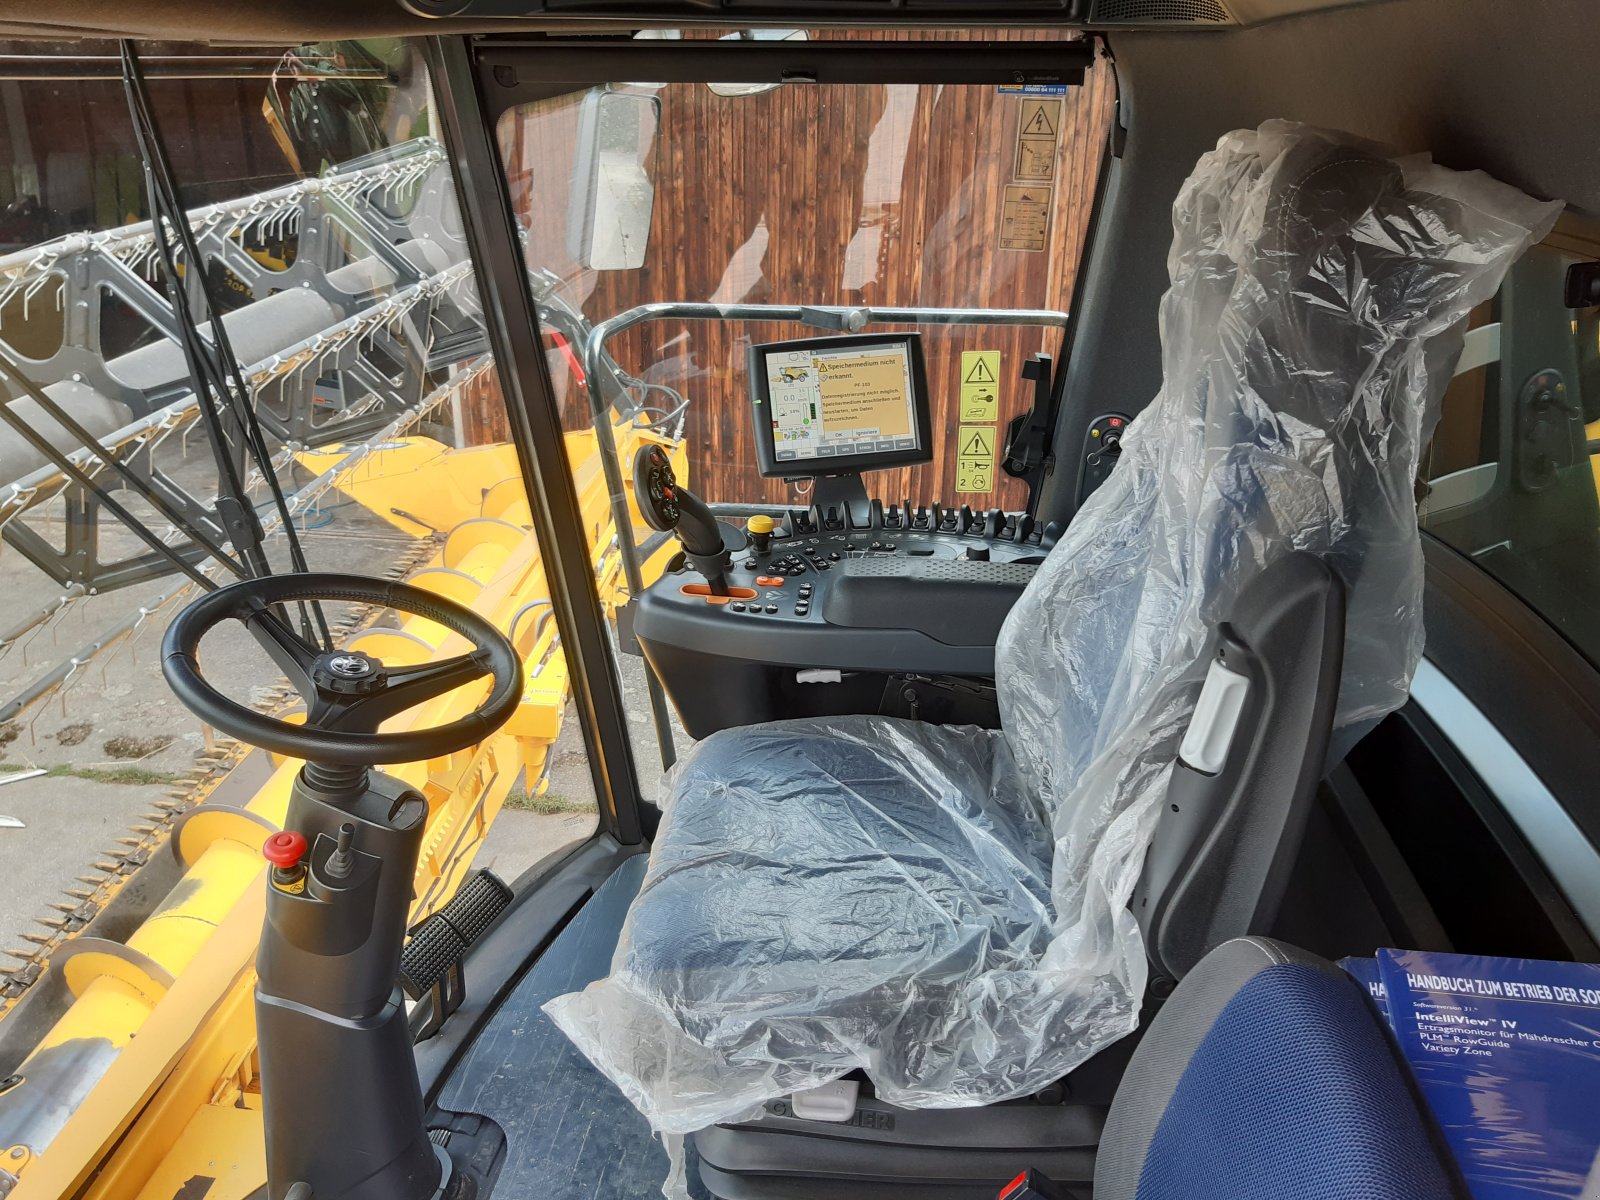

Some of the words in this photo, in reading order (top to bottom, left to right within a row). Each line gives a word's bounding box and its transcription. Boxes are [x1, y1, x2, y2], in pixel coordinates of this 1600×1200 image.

[828, 361, 879, 370] Speichermedium
[828, 372, 854, 380] erkannt.
[960, 479, 966, 487] 2
[1406, 973, 1475, 994] HANDBUCH
[1476, 979, 1503, 996] ZUM
[1503, 982, 1553, 1001] BETRIEB
[1553, 986, 1580, 1003] DER
[1413, 1001, 1462, 1011] Softwareversion
[1501, 1020, 1517, 1029] IV
[1418, 1022, 1496, 1037] Ertragsmonitor
[1500, 1030, 1515, 1039] für
[1518, 1032, 1590, 1047] Mähdrescher
[1453, 1036, 1511, 1049] RowGuide
[1421, 1042, 1460, 1055] Variety
[1463, 1047, 1493, 1057] Zone
